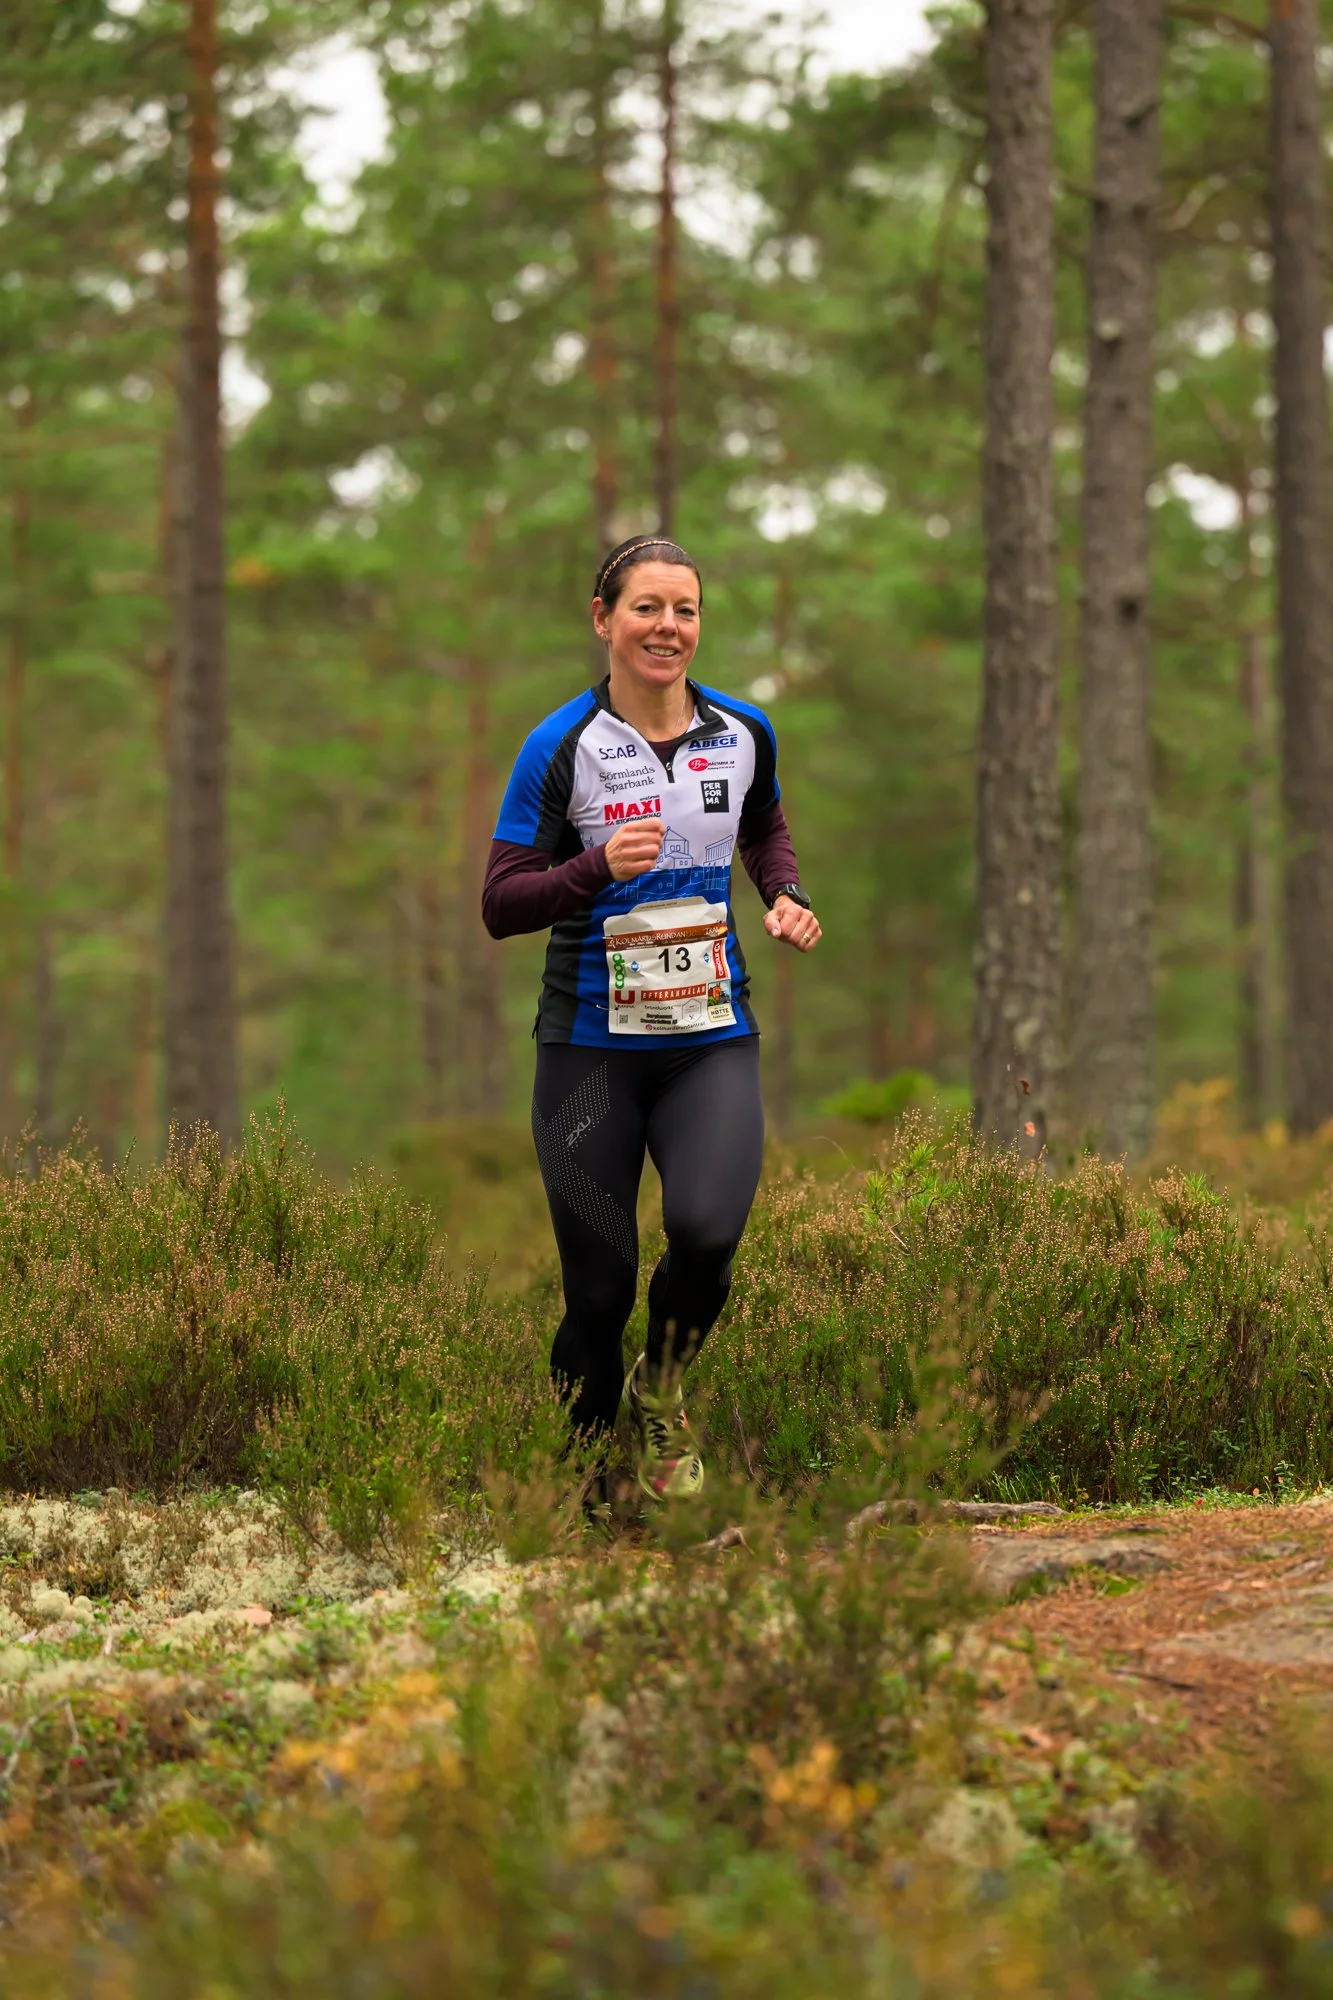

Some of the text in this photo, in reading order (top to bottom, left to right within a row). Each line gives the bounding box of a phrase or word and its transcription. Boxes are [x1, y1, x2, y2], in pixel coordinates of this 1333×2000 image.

[599, 744, 637, 760] SSAB
[688, 737, 737, 750] ABECE
[599, 765, 656, 783] Sörmlands
[604, 776, 656, 794] Sparbank
[703, 782, 721, 790] PER
[704, 790, 722, 798] FOR
[705, 797, 720, 805] MA
[604, 799, 661, 821] MAXI
[658, 946, 692, 974] 13
[565, 1115, 591, 1147] 2XU
